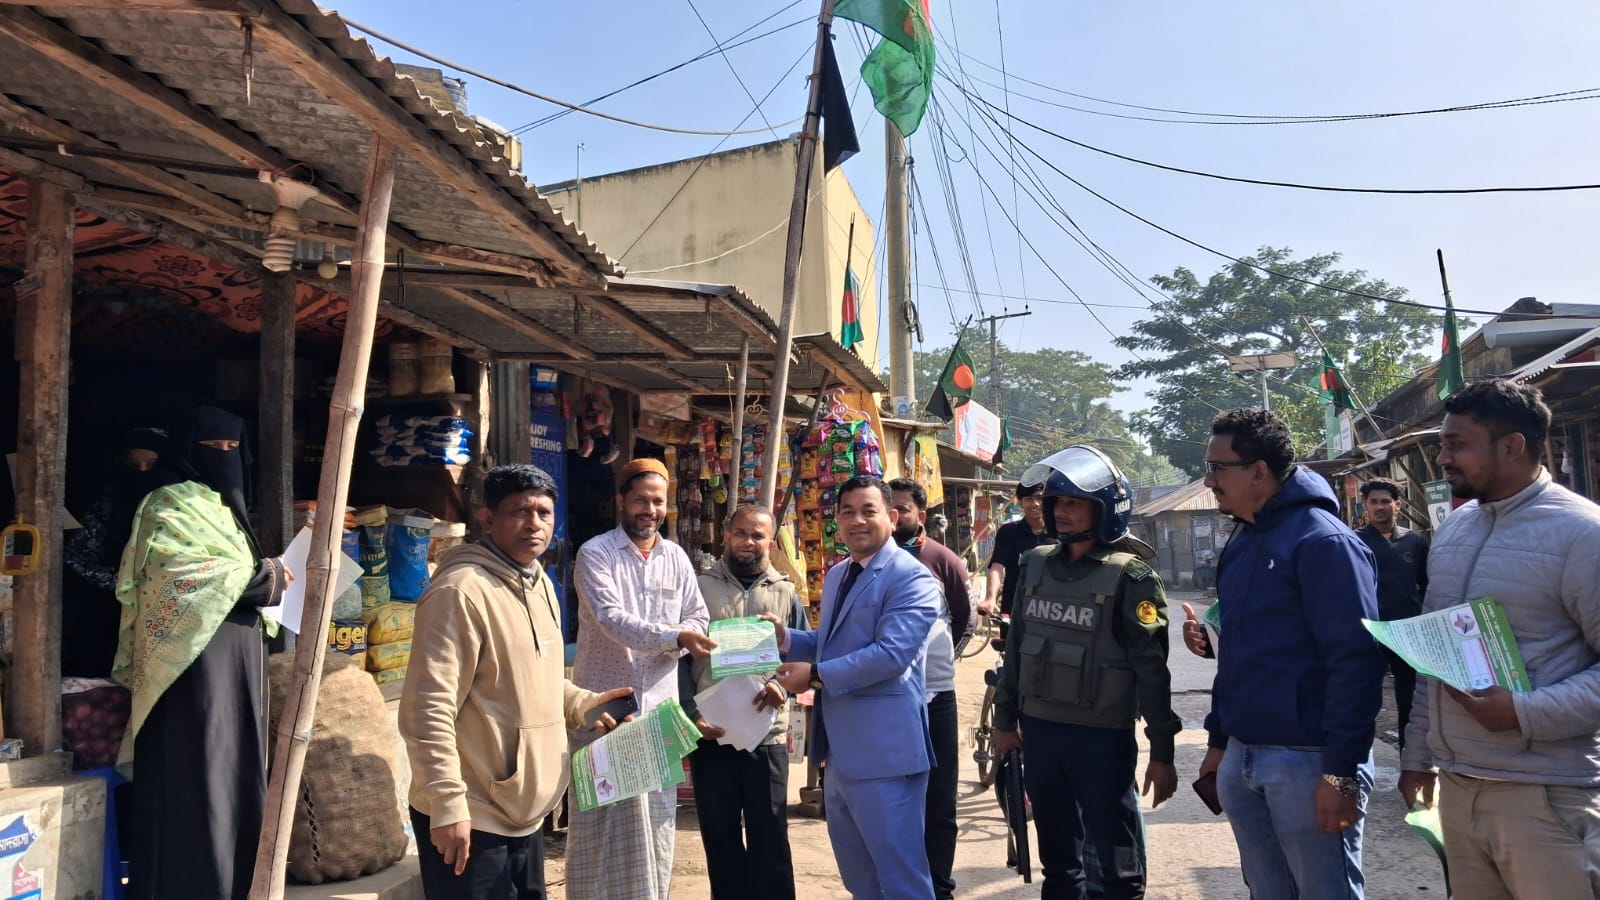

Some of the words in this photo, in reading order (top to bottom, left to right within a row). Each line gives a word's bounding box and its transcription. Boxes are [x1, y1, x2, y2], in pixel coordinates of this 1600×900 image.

[530, 423, 547, 437] JOY
[530, 436, 562, 452] RESHING
[1114, 499, 1131, 515] ANSAR
[1025, 598, 1095, 628] ANSAR
[328, 621, 367, 651] iger
